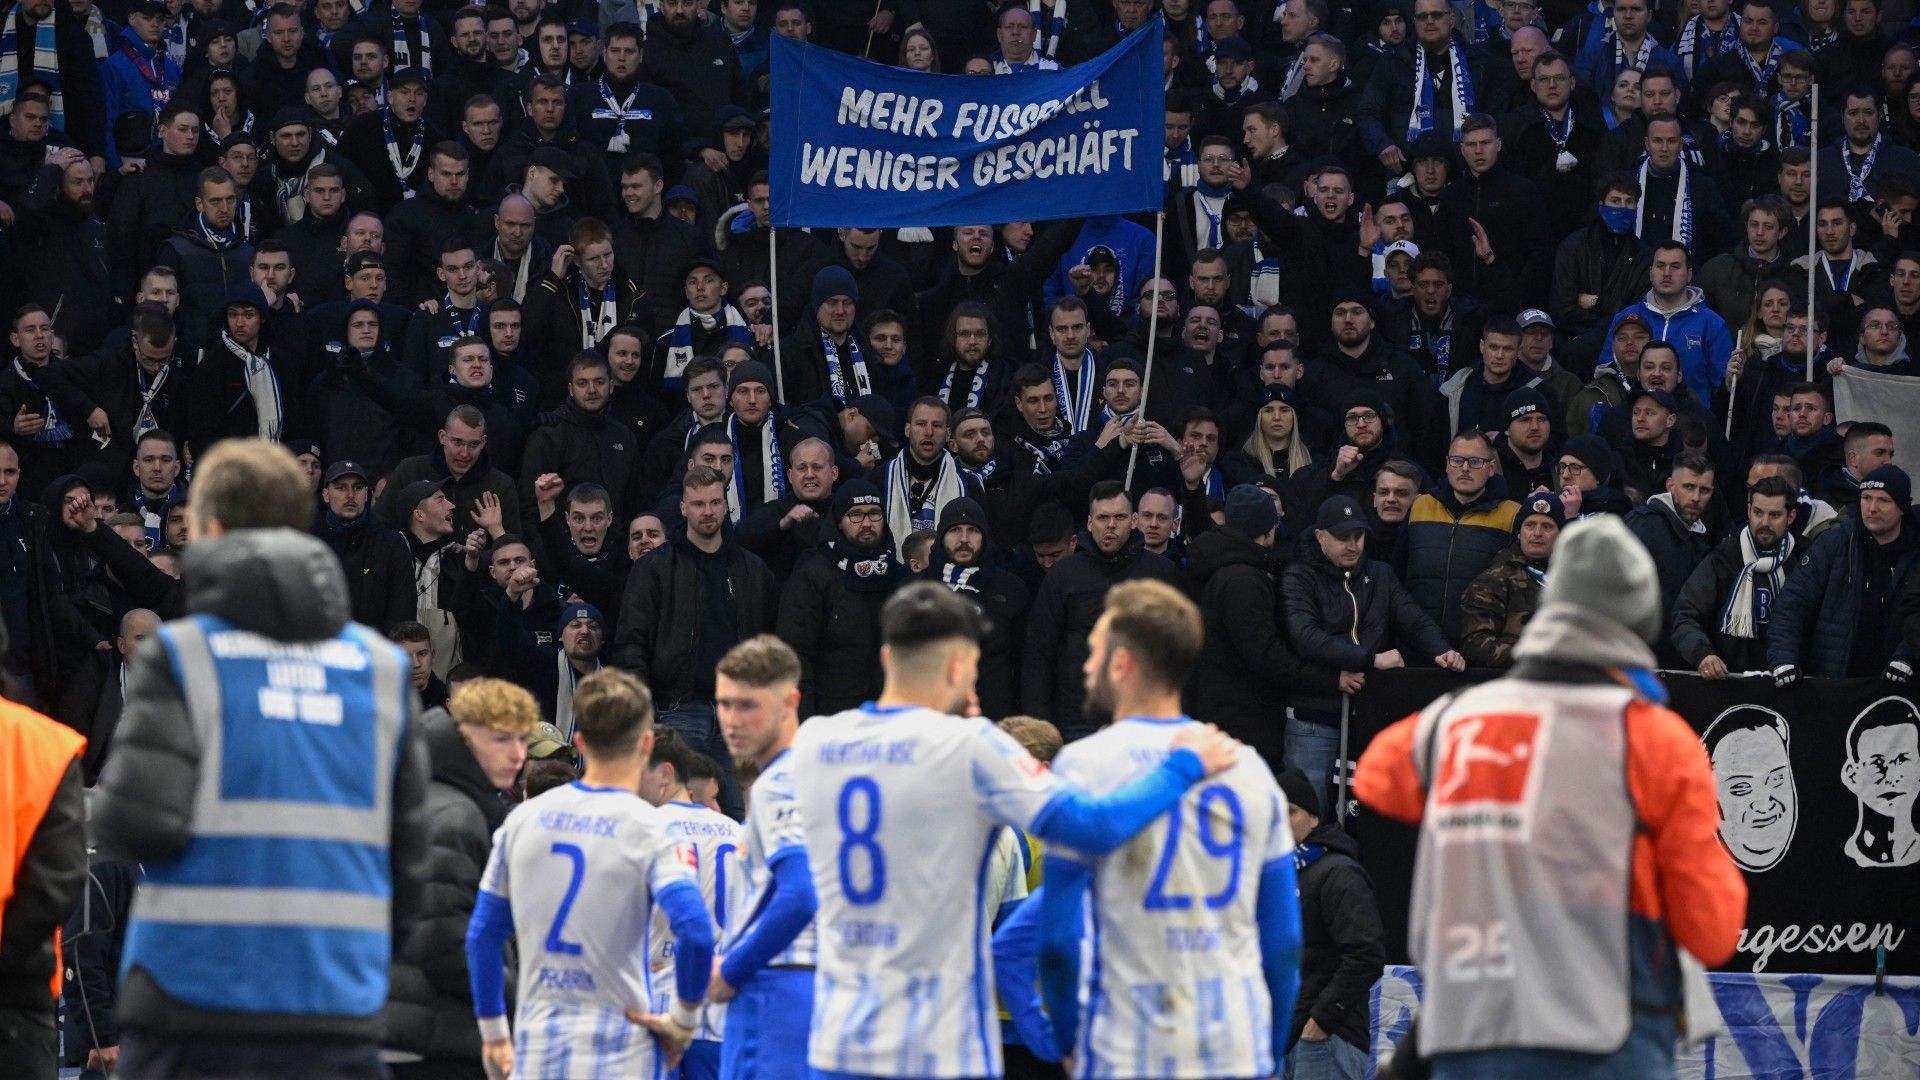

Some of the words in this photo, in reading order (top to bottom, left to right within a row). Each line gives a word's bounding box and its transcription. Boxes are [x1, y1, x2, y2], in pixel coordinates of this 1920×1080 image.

[838, 86, 943, 138] MEHR
[801, 143, 960, 192] WENIGER
[973, 119, 1138, 187] GESCHÄFT
[838, 775, 886, 907] 8
[545, 843, 585, 956] 2
[1446, 923, 1516, 981] 25
